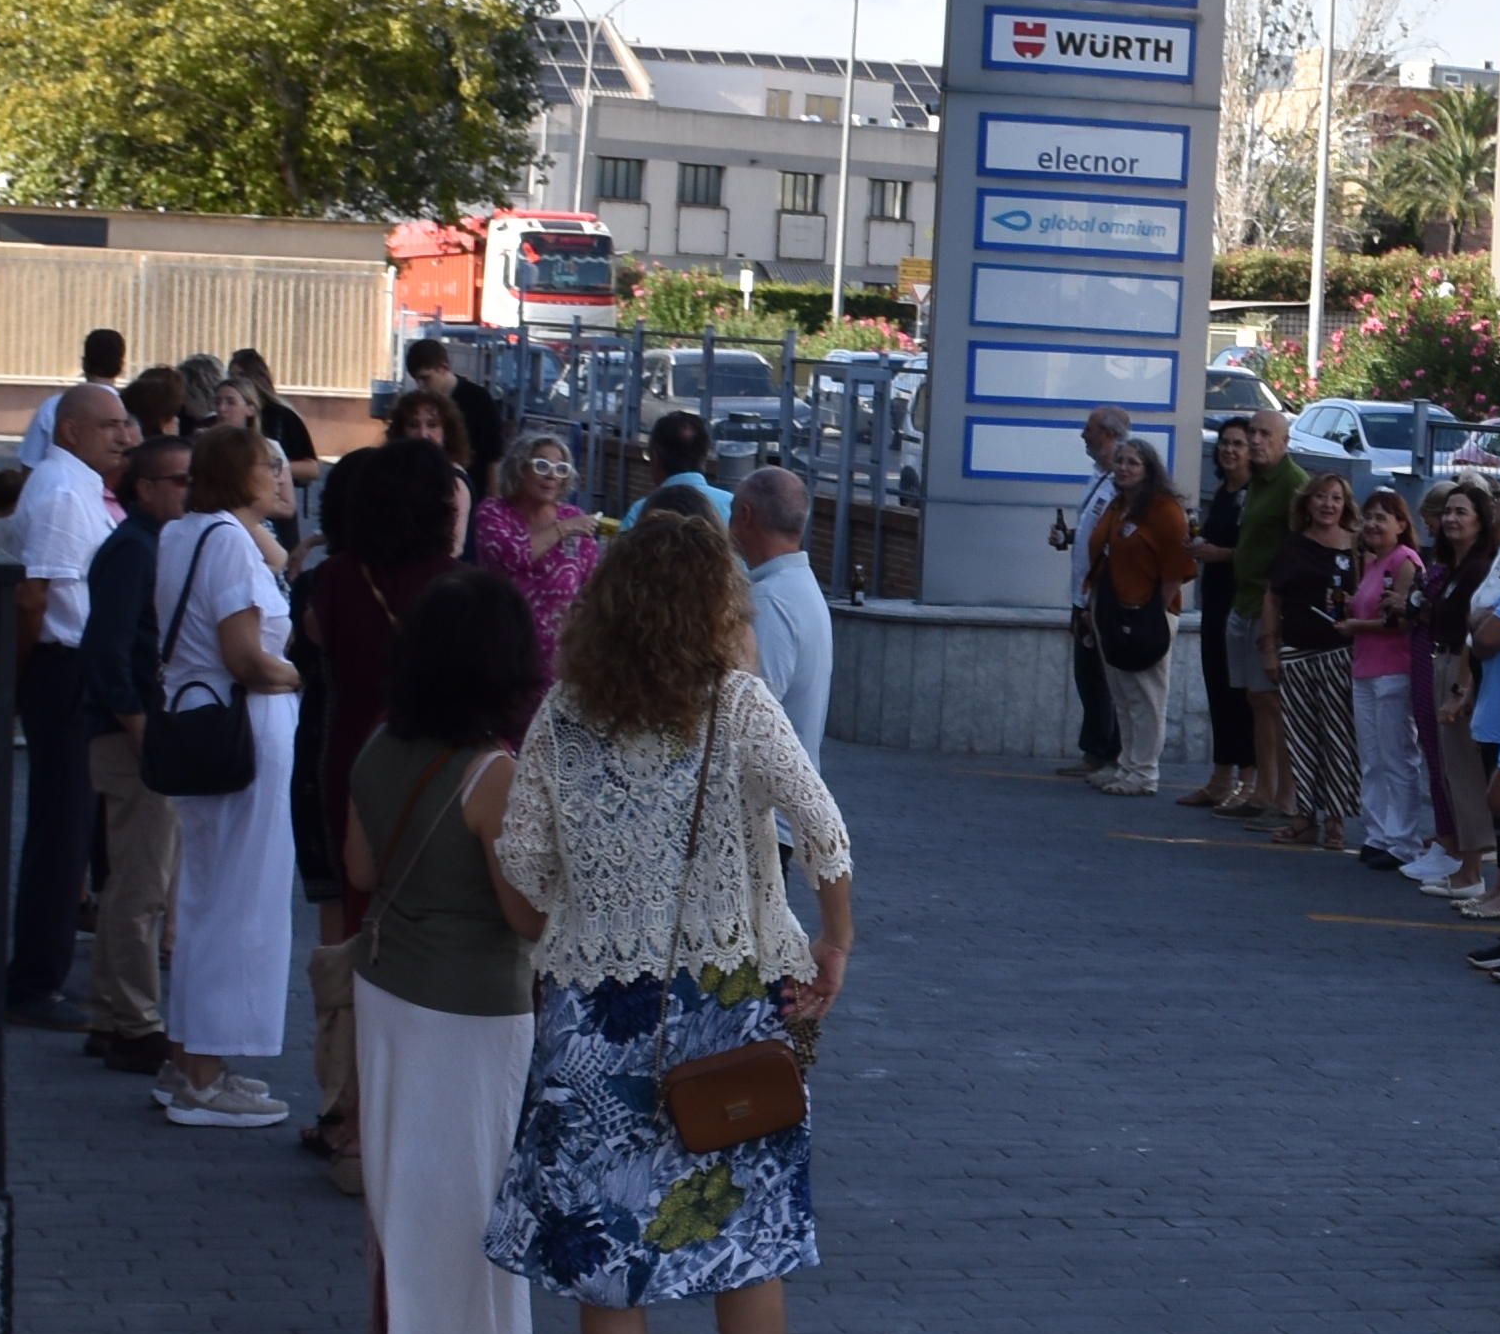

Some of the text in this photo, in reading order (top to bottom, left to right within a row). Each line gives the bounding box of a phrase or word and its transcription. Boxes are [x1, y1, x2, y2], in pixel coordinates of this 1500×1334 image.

[1055, 31, 1173, 64] WÜRTH
[1037, 146, 1140, 175] elecnor
[1038, 214, 1167, 237] global omnium
